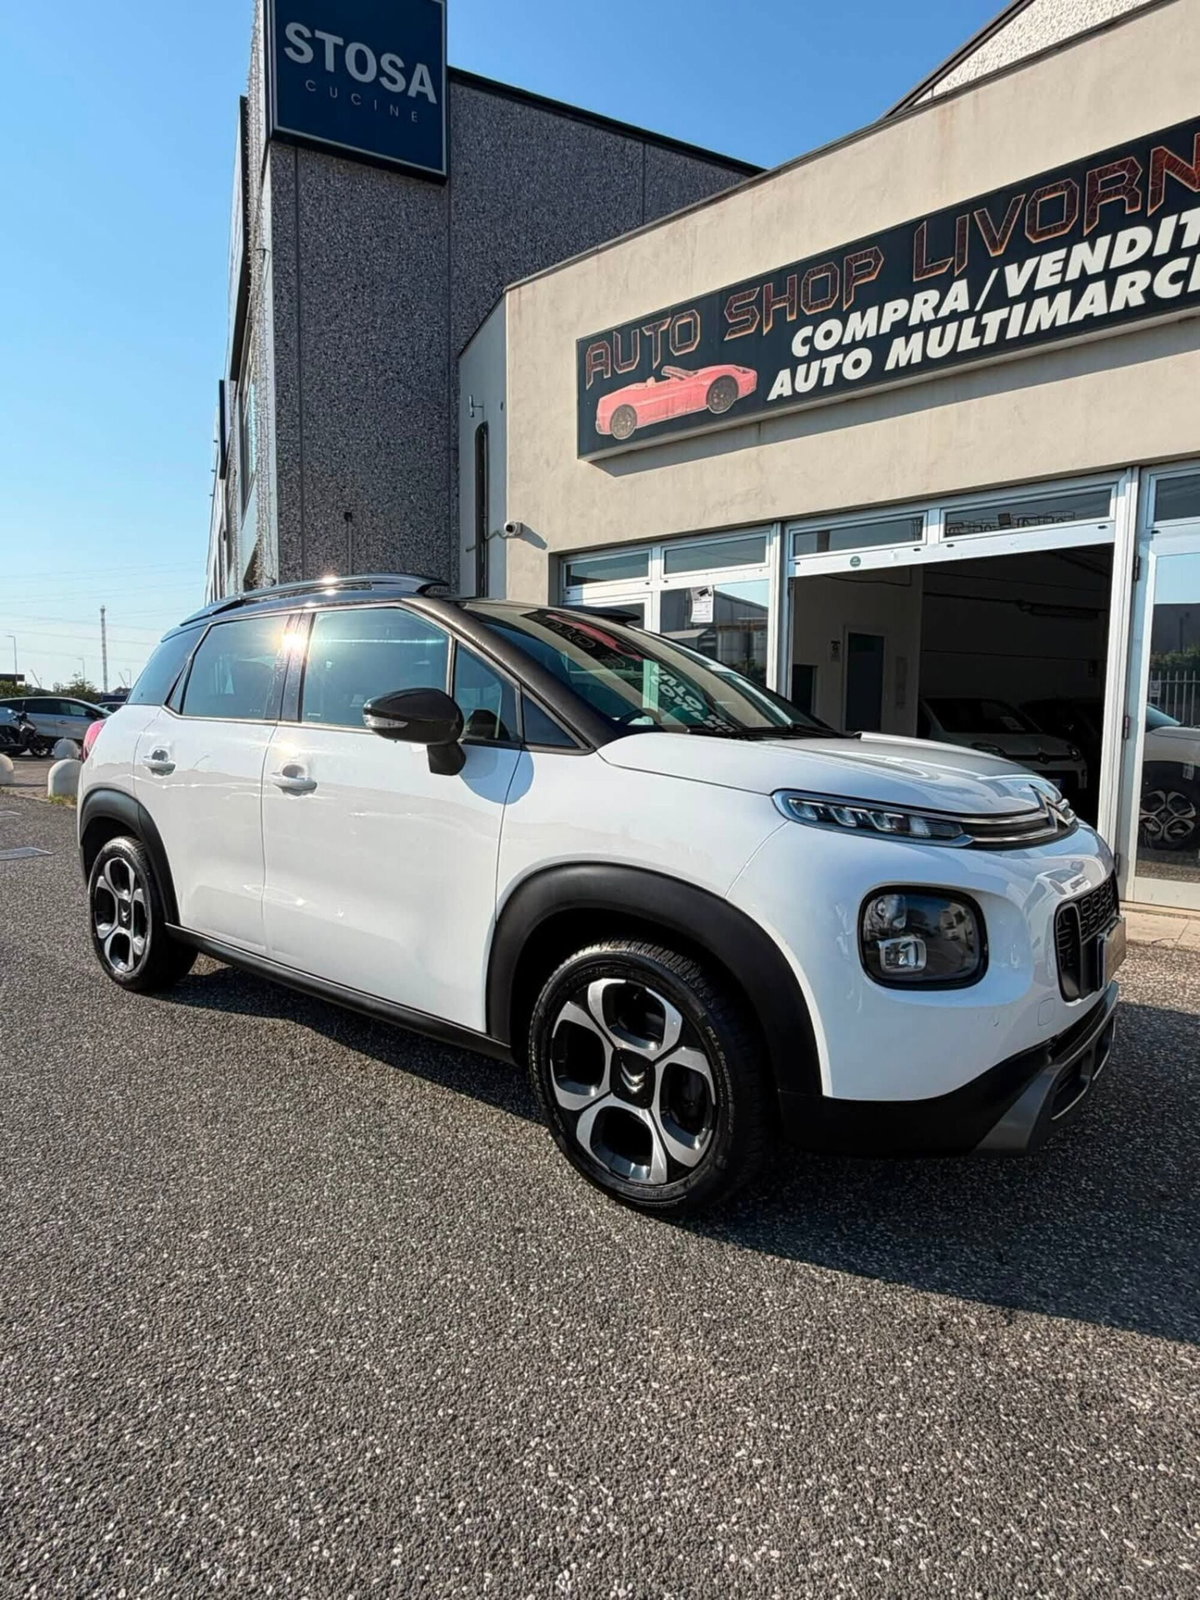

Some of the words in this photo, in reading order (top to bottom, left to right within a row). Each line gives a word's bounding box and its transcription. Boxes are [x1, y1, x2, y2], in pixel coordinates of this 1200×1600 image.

[284, 21, 438, 104] STOSA
[305, 79, 418, 123] CUCINE
[585, 309, 700, 390] AUTO
[724, 245, 885, 342] SHOP
[913, 132, 1200, 283] LIVORN
[767, 346, 873, 401] AUTO
